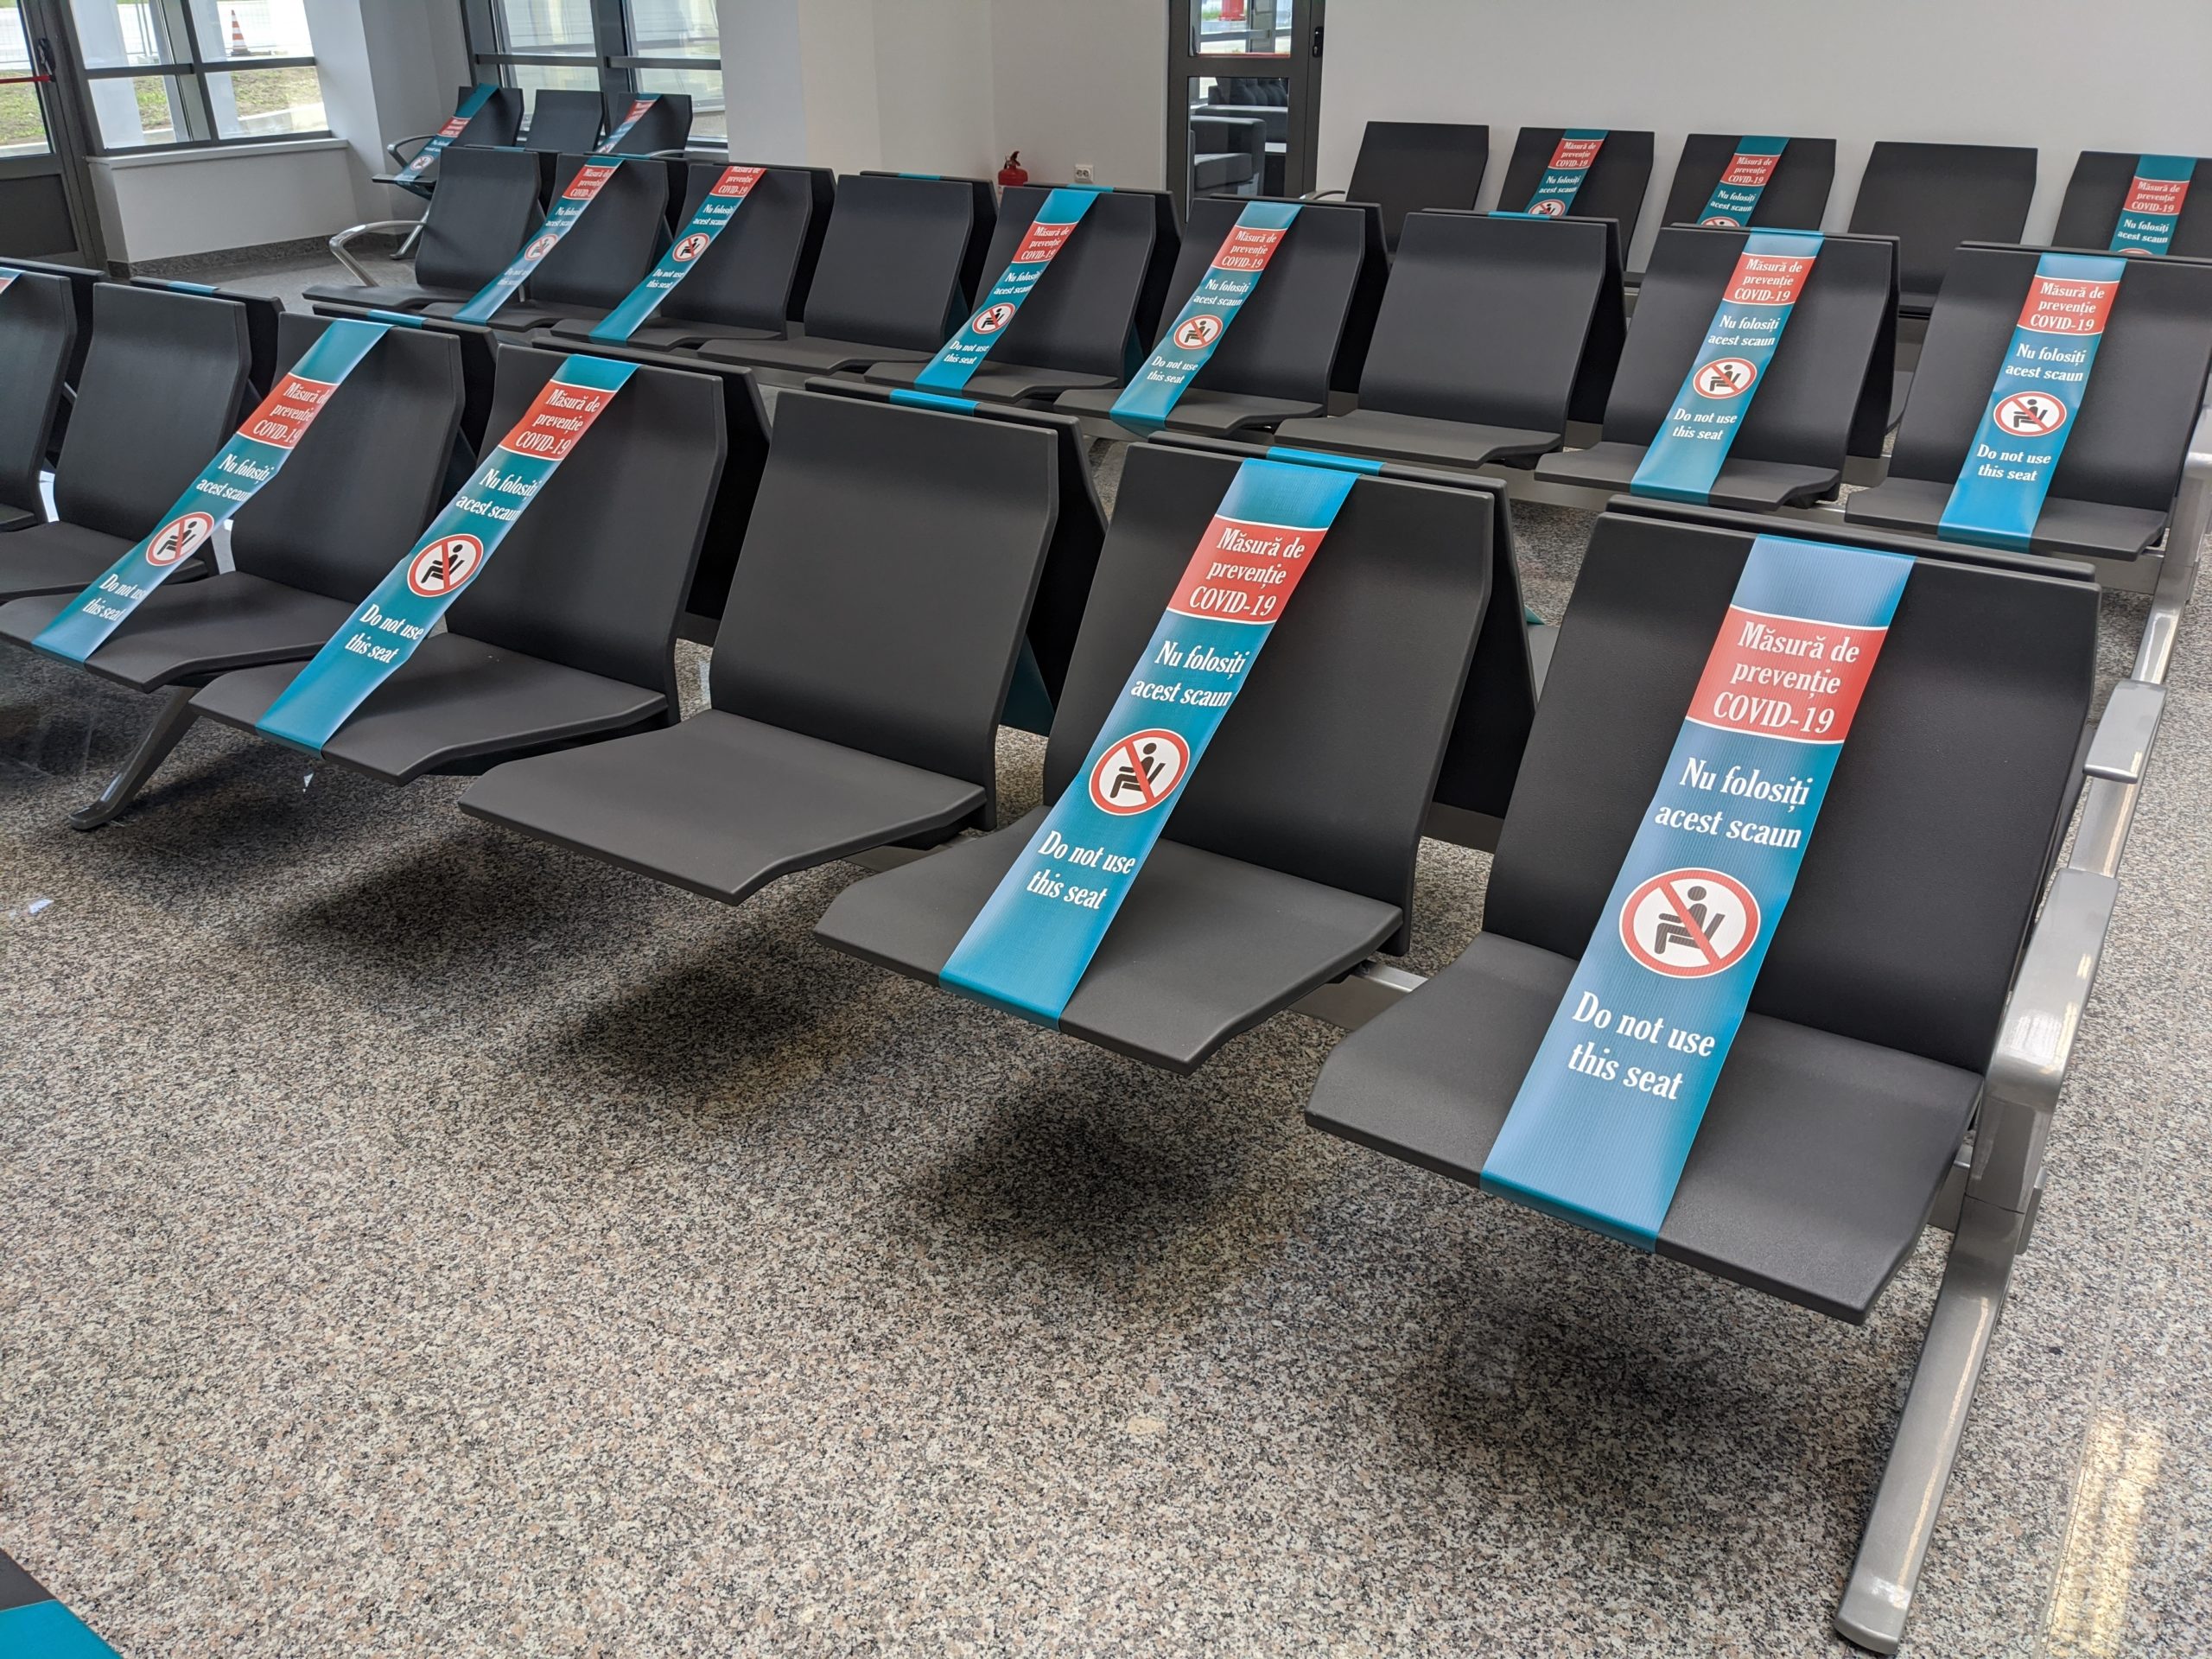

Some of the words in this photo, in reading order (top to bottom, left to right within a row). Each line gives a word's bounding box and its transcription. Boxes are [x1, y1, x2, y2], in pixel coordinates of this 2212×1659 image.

[1728, 175, 1764, 183] COVID-19
[1733, 166, 1766, 175] prevenție
[2138, 181, 2169, 192] Măsură
[2137, 192, 2175, 202] prevenție
[702, 204, 713, 213] Nu
[2132, 201, 2174, 213] COVID-19
[1034, 226, 1061, 236] Măsură
[1062, 226, 1069, 235] de
[2124, 219, 2136, 228] Nu
[2139, 221, 2169, 233] folosiți
[1236, 231, 1266, 243] Măsură
[1267, 232, 1277, 243] de
[2118, 231, 2140, 240] acest
[1021, 250, 1056, 260] COVID-19
[1230, 245, 1268, 257] prevenție
[1222, 256, 1263, 268] COVID-19
[1745, 258, 1787, 272] Măsură
[1789, 261, 1802, 273] de
[652, 269, 662, 277] Do
[1005, 272, 1016, 282] Nu
[1205, 279, 1218, 290] Nu
[1218, 281, 1251, 295] folosiți
[1742, 275, 1794, 289] prevenție
[2040, 282, 2087, 298] Măsură
[2089, 286, 2105, 299] de
[1193, 295, 1217, 304] acest
[1217, 297, 1243, 306] scaun
[1734, 288, 1791, 302] COVID-19
[2038, 300, 2096, 315] prevenție
[1719, 315, 1737, 328] Nu
[1738, 317, 1781, 333] folosiți
[2031, 314, 2094, 331] COVID-19
[950, 340, 962, 350] Do
[1708, 334, 1740, 346] acest
[1741, 337, 1776, 346] scaun
[944, 353, 959, 363] this
[959, 355, 977, 365] seat
[1152, 356, 1166, 365] Do
[1166, 359, 1182, 370] not
[1182, 362, 1198, 371] use
[2016, 343, 2037, 359] Nu
[2037, 346, 2088, 367] folosiți
[1147, 371, 1164, 381] this
[1165, 374, 1185, 384] seat
[2005, 364, 2041, 378] acest
[2044, 369, 2084, 382] scaun
[283, 382, 321, 403] Măsură
[545, 389, 588, 410] Măsură
[585, 396, 601, 413] de
[532, 413, 584, 435] prevenție
[1674, 408, 1691, 421] Do
[1694, 411, 1715, 423] not
[1716, 413, 1738, 424] use
[1673, 425, 1697, 438] this
[1697, 427, 1724, 441] seat
[515, 430, 572, 455] COVID-19
[1977, 444, 1998, 459] Do
[1999, 449, 2024, 463] not
[2026, 451, 2051, 465] use
[218, 454, 237, 473] Nu
[479, 468, 499, 489] Nu
[1978, 464, 2005, 479] this
[2006, 468, 2038, 481] seat
[196, 479, 228, 496] acest
[456, 495, 493, 516] acest
[1217, 527, 1282, 556] Măsură
[1282, 537, 1306, 559] de
[1206, 561, 1287, 589] prevenție
[99, 574, 117, 592] Do
[114, 584, 137, 597] not
[83, 598, 106, 616] this
[99, 607, 127, 621] seat
[1189, 586, 1277, 617] COVID-19
[359, 603, 382, 626] Do
[379, 618, 406, 634] not
[400, 624, 425, 640] use
[345, 632, 372, 655] this
[367, 644, 400, 664] seat
[1738, 620, 1825, 660] Măsură
[1830, 637, 1860, 664] de
[1154, 640, 1183, 667] Nu
[1183, 645, 1250, 680] folosiți
[1729, 663, 1841, 699] prevenție
[1131, 680, 1182, 702] acest
[1180, 687, 1233, 707] scaun
[1713, 691, 1835, 734] COVID-19
[1679, 757, 1717, 791] Nu
[1719, 766, 1814, 813] folosiți
[1655, 806, 1724, 836] acest
[1726, 820, 1802, 849] scaun
[1038, 830, 1069, 859] Do
[1068, 847, 1104, 868] not
[1102, 854, 1136, 874] use
[1027, 868, 1065, 899] this
[1064, 886, 1108, 910] seat
[1572, 990, 1611, 1029] Do
[1616, 1017, 1664, 1044] not
[1668, 1027, 1715, 1057] use
[1567, 1041, 1619, 1080] this
[1623, 1066, 1683, 1100] seat
